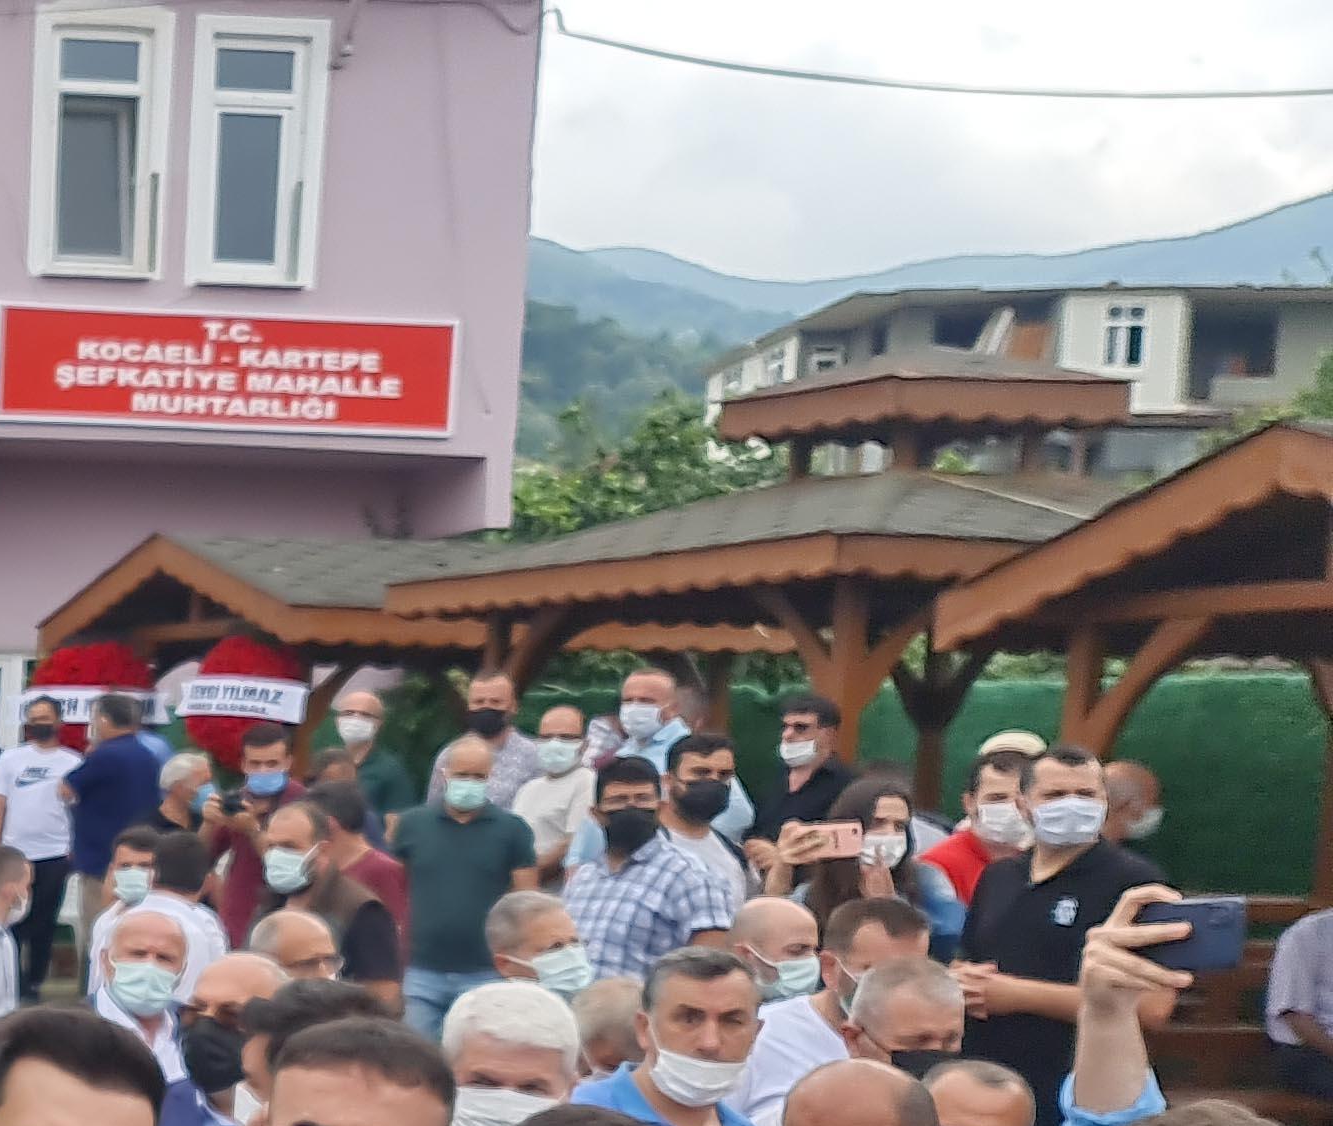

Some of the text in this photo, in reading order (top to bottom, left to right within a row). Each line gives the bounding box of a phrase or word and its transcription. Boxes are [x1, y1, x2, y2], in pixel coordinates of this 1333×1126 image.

[203, 320, 263, 343] T.C.
[77, 340, 213, 365] KOCAELİ
[239, 348, 381, 373] KARTEPE
[55, 363, 402, 398] ŞEFKATİYE MAHALLE
[131, 392, 338, 420] MUHTARLIĞI
